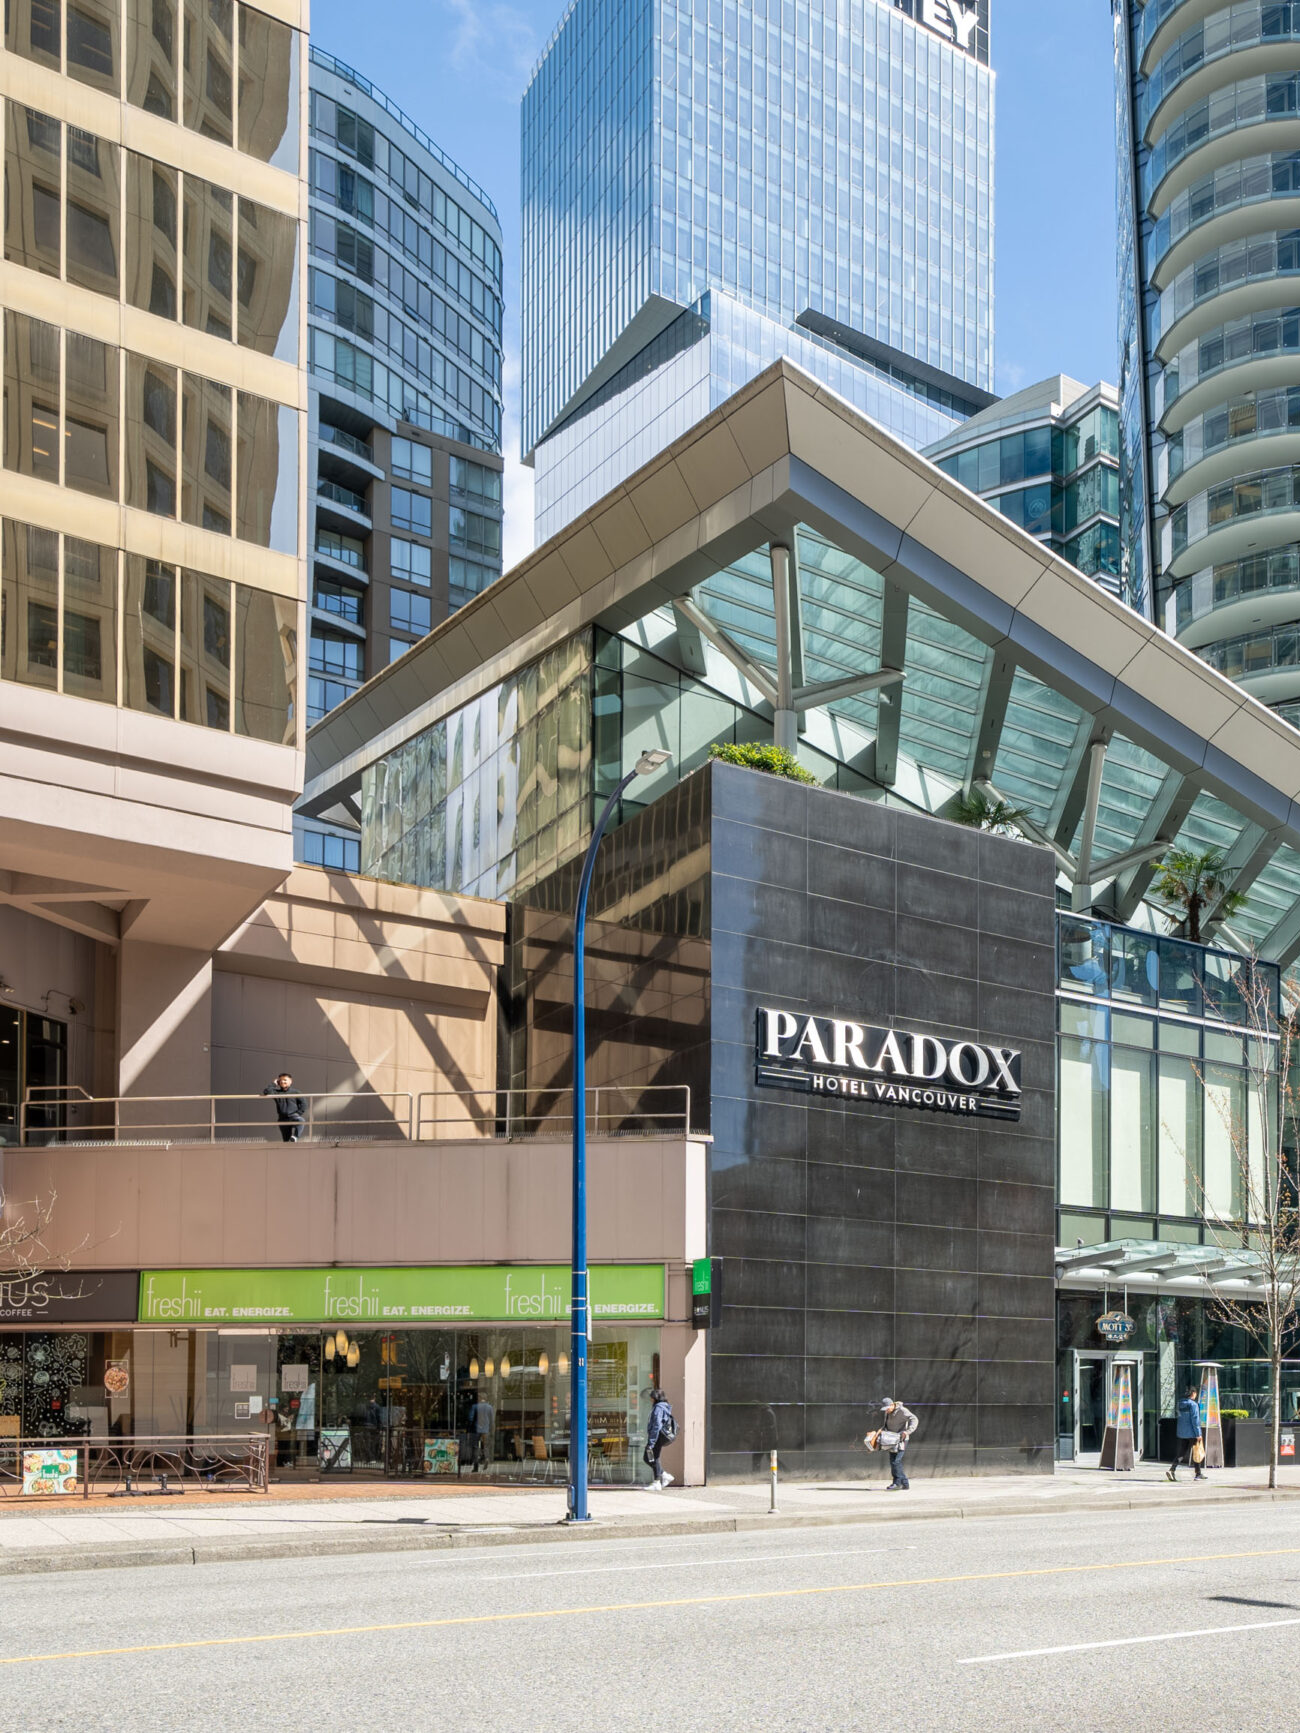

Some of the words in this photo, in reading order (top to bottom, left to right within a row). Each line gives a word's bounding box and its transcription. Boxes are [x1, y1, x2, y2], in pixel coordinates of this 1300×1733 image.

[763, 1007, 1022, 1093] PARADOX
[813, 1076, 868, 1096] HOTEL
[875, 1084, 977, 1110] VANCOUVER
[147, 1277, 202, 1317] freshii
[204, 1307, 229, 1317] EAT.
[232, 1306, 294, 1317] ENERGIZE.
[324, 1275, 379, 1316] freshii
[383, 1306, 408, 1315] EAT.
[411, 1305, 474, 1315] ENERGIZE.
[504, 1273, 562, 1314] freshii
[594, 1303, 659, 1313] ENERGIZE.
